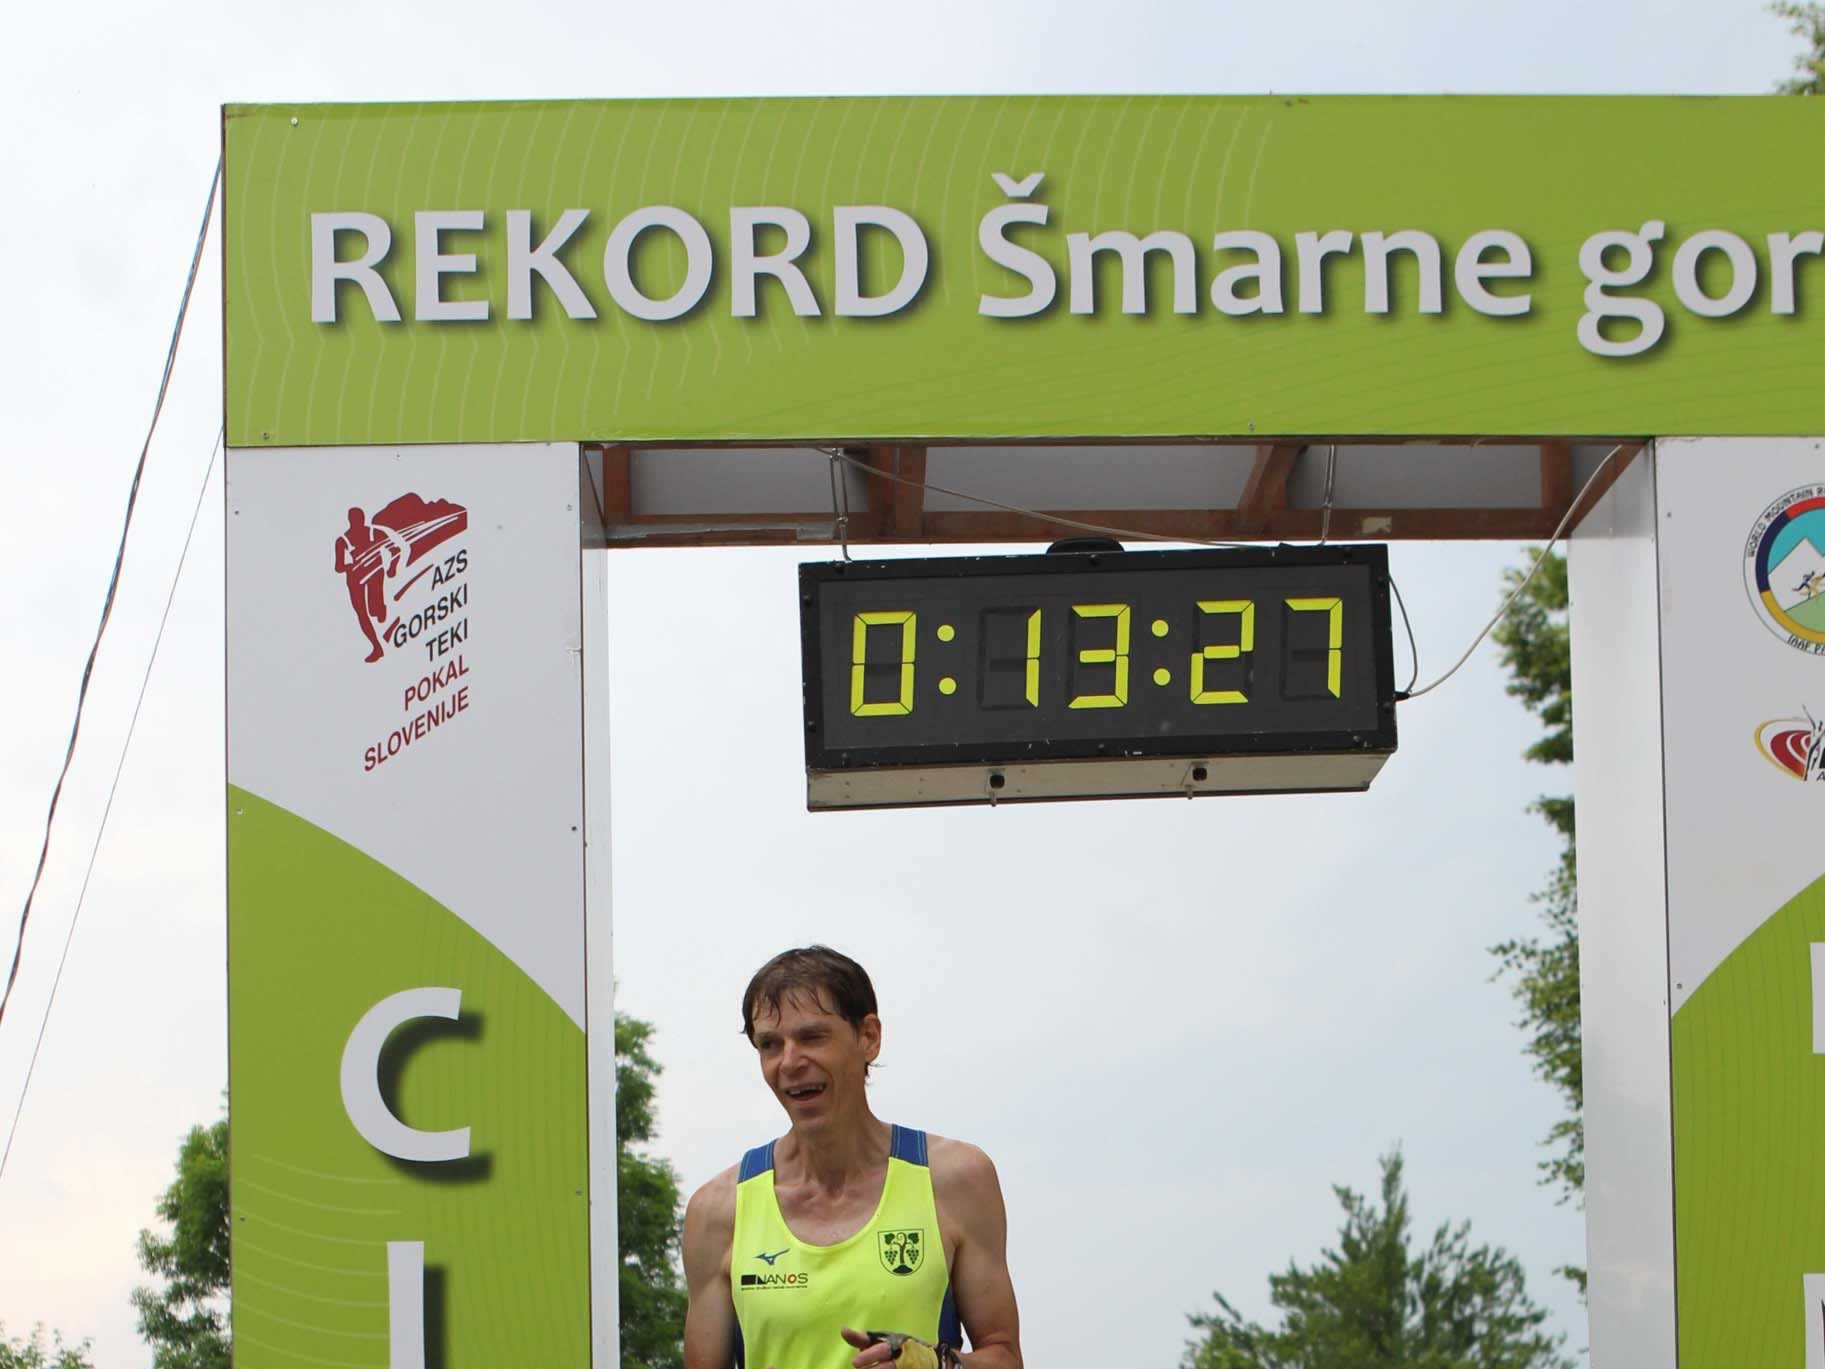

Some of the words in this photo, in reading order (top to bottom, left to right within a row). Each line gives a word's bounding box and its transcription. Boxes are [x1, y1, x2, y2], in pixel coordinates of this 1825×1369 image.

[310, 205, 929, 323] REKORD
[977, 172, 1533, 318] Šmarne
[1576, 220, 1825, 357] gor
[431, 549, 468, 590] AZS
[393, 583, 468, 649] GORSKI
[425, 618, 468, 662] TEKI
[403, 654, 470, 712] POKAL
[850, 597, 1343, 717] 0:13:27
[363, 686, 470, 772] SLOVENIJE
